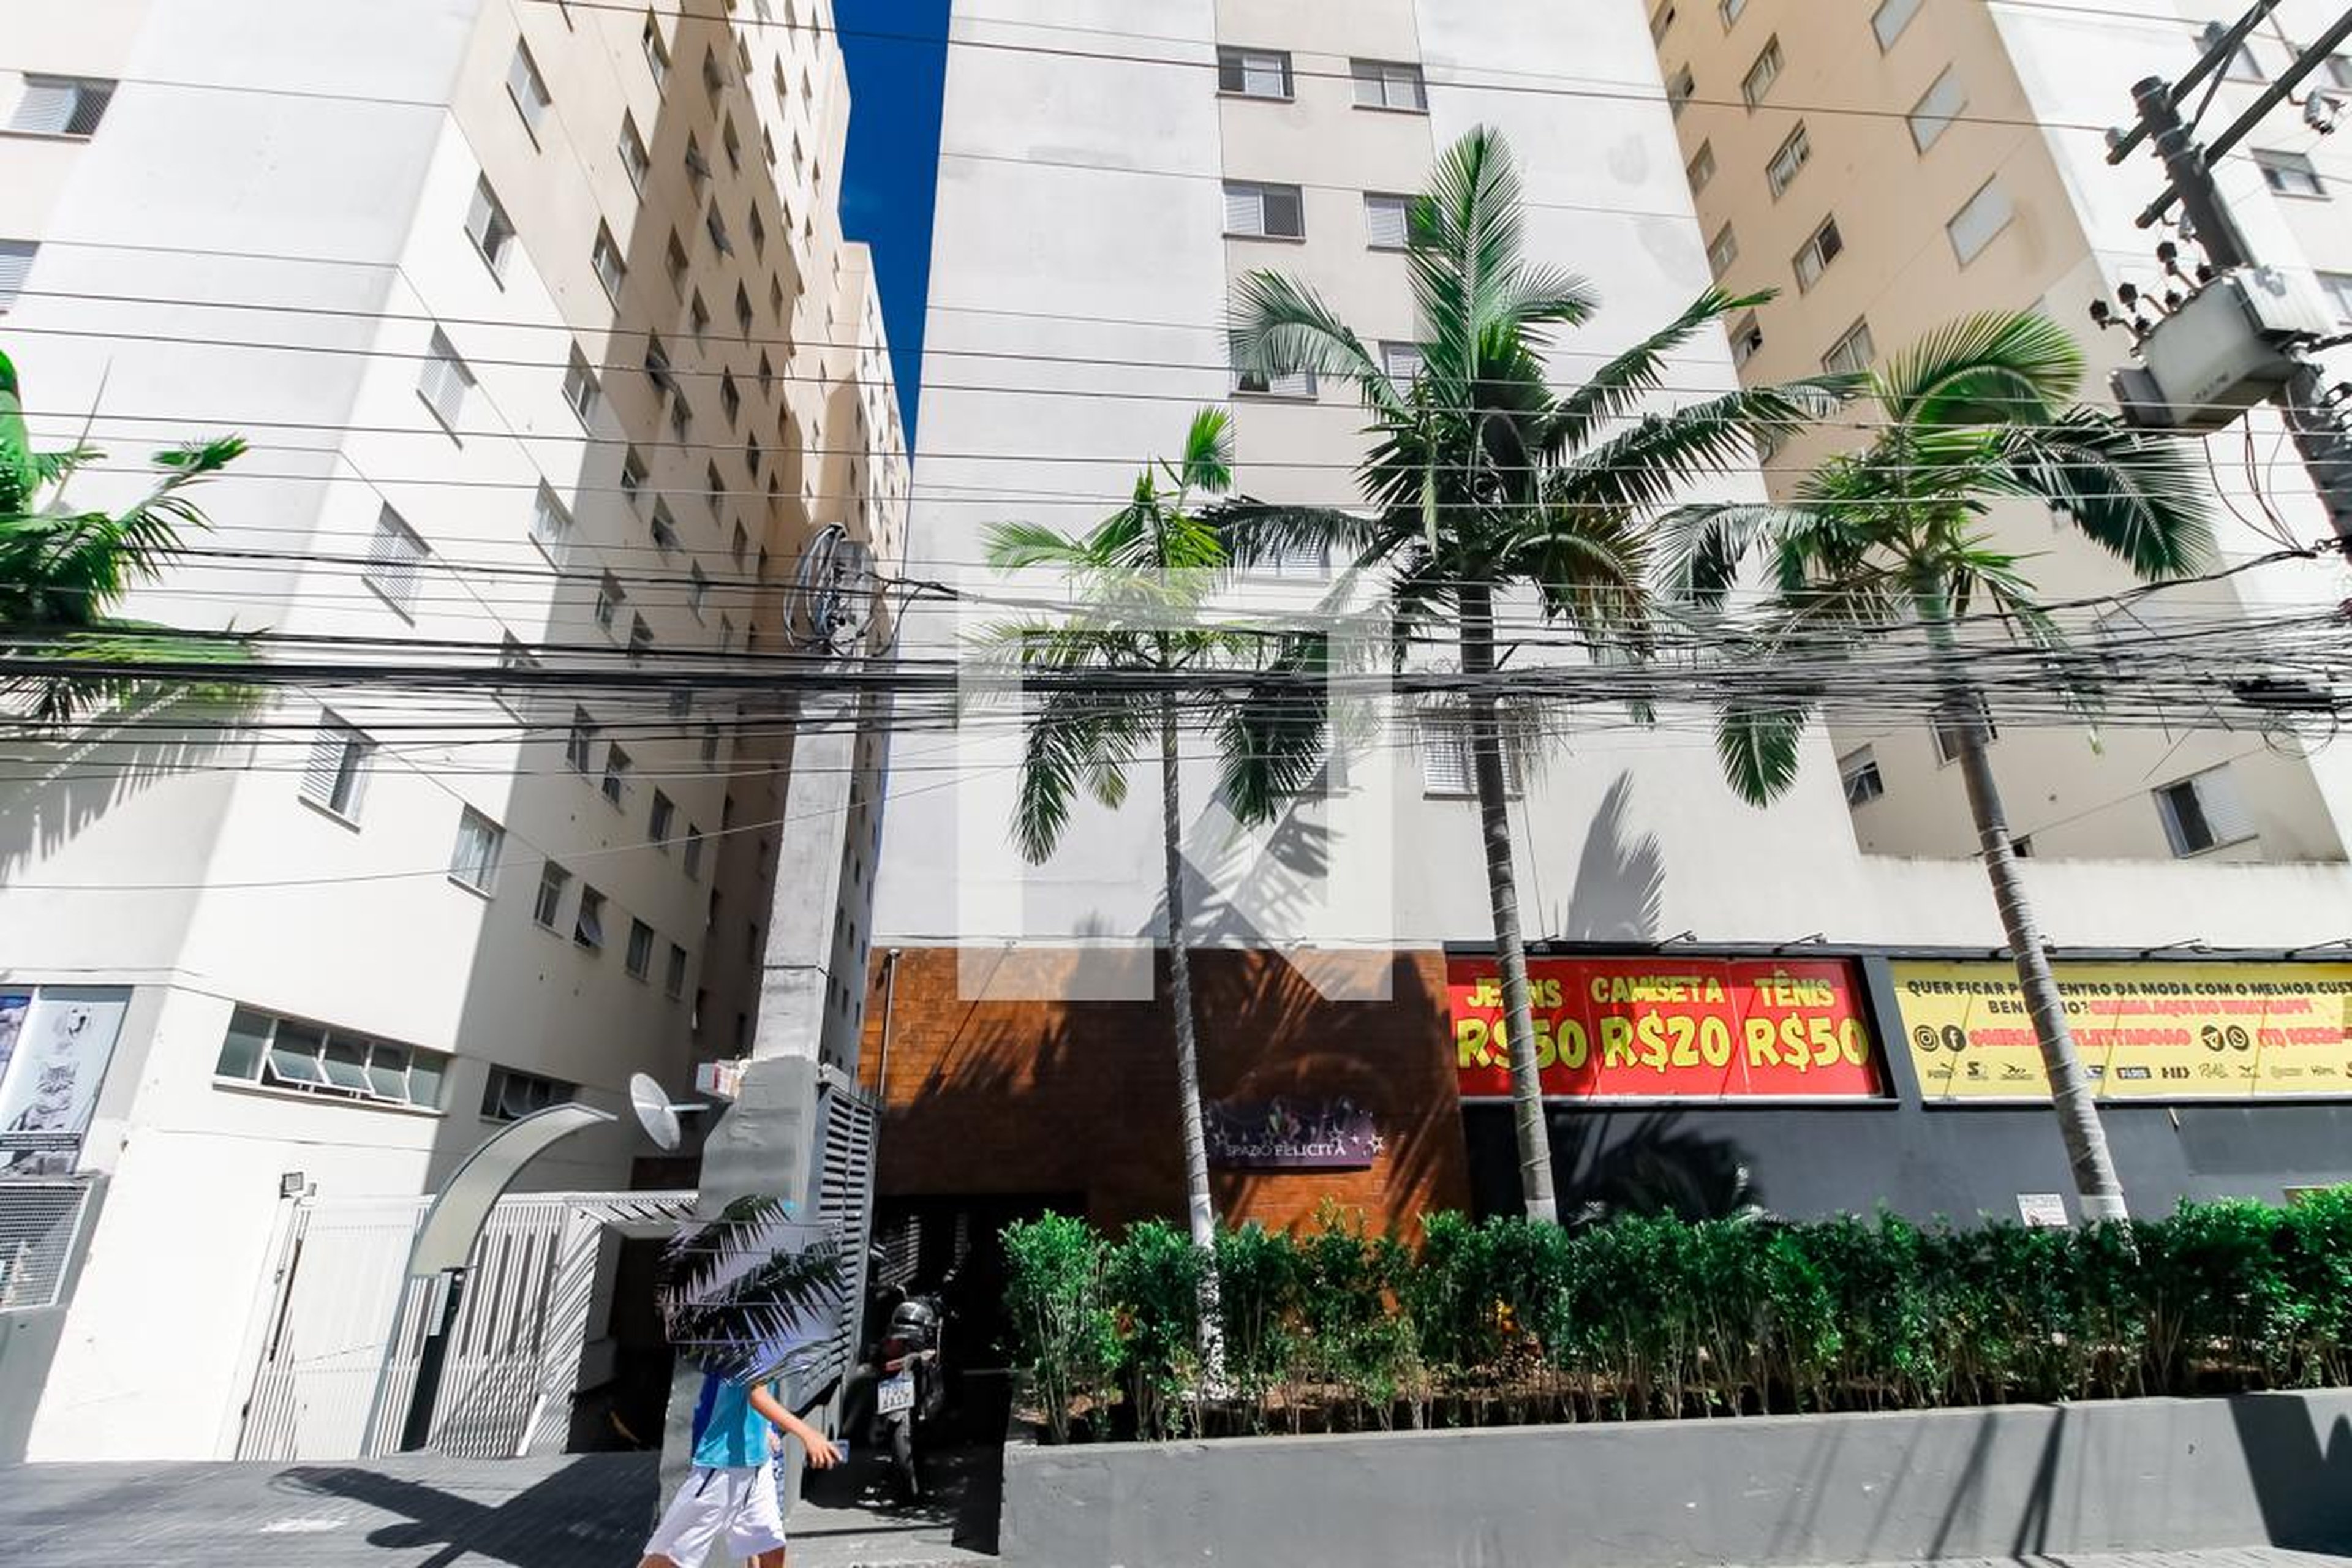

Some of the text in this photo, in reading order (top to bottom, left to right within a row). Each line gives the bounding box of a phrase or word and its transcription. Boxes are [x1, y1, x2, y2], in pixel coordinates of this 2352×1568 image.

[1467, 978, 1562, 1008] JENS
[1591, 975, 1724, 1003] CAMISETA
[1754, 969, 1835, 1008] TÊNIS
[1907, 981, 1954, 997] QUER
[1957, 981, 2007, 995] FICAR
[2057, 982, 2112, 996] ENTRO
[2114, 982, 2138, 995] DA
[2143, 982, 2193, 995] MODA
[2195, 982, 2234, 995] COM
[2235, 982, 2247, 995] O
[2250, 982, 2316, 995] MELHOR
[1600, 1009, 1731, 1073] R$20
[1745, 1011, 1869, 1072] R$50
